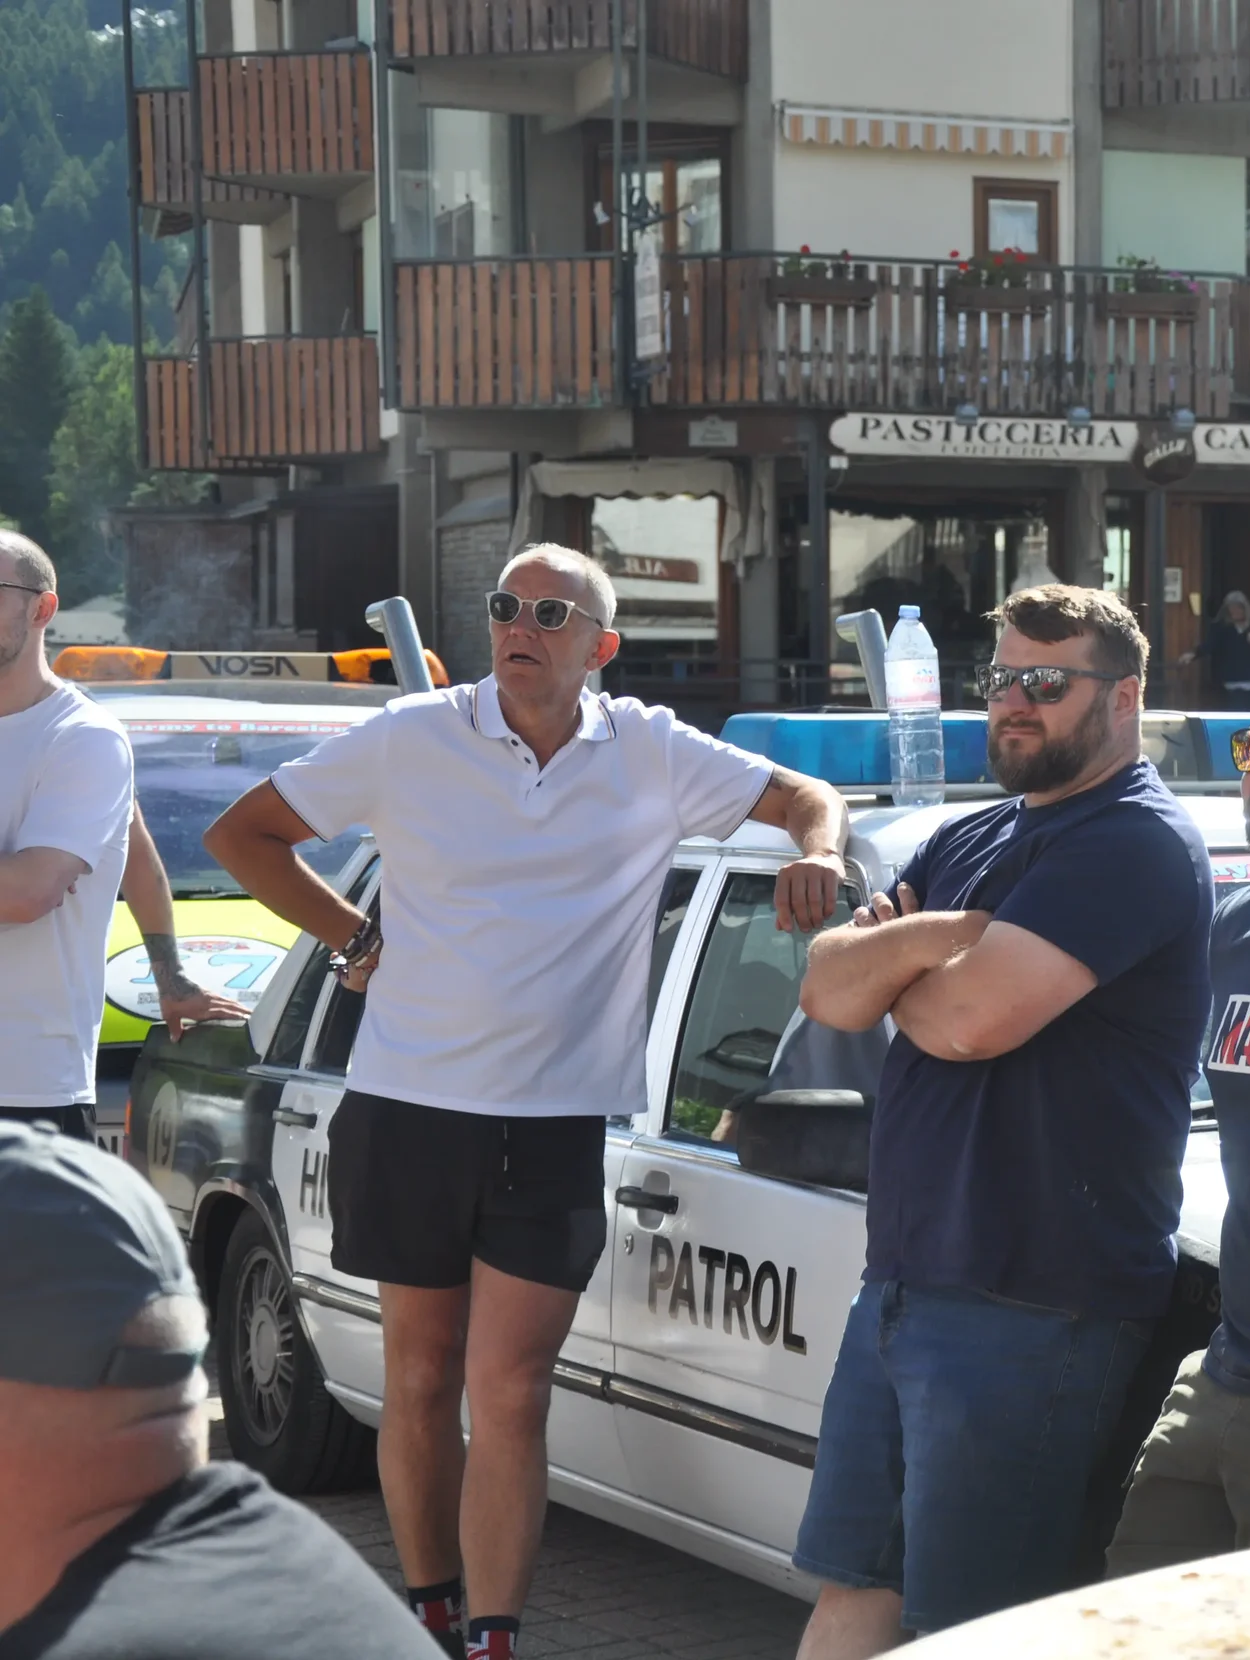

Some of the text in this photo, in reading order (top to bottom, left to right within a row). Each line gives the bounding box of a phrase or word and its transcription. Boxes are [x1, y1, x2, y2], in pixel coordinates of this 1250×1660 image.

[858, 416, 1122, 447] PASTICCERIA
[197, 655, 300, 677] VOSA
[206, 723, 232, 732] to
[239, 723, 349, 733] Barcelon
[152, 1104, 173, 1167] 19
[648, 1235, 807, 1356] PATROL
